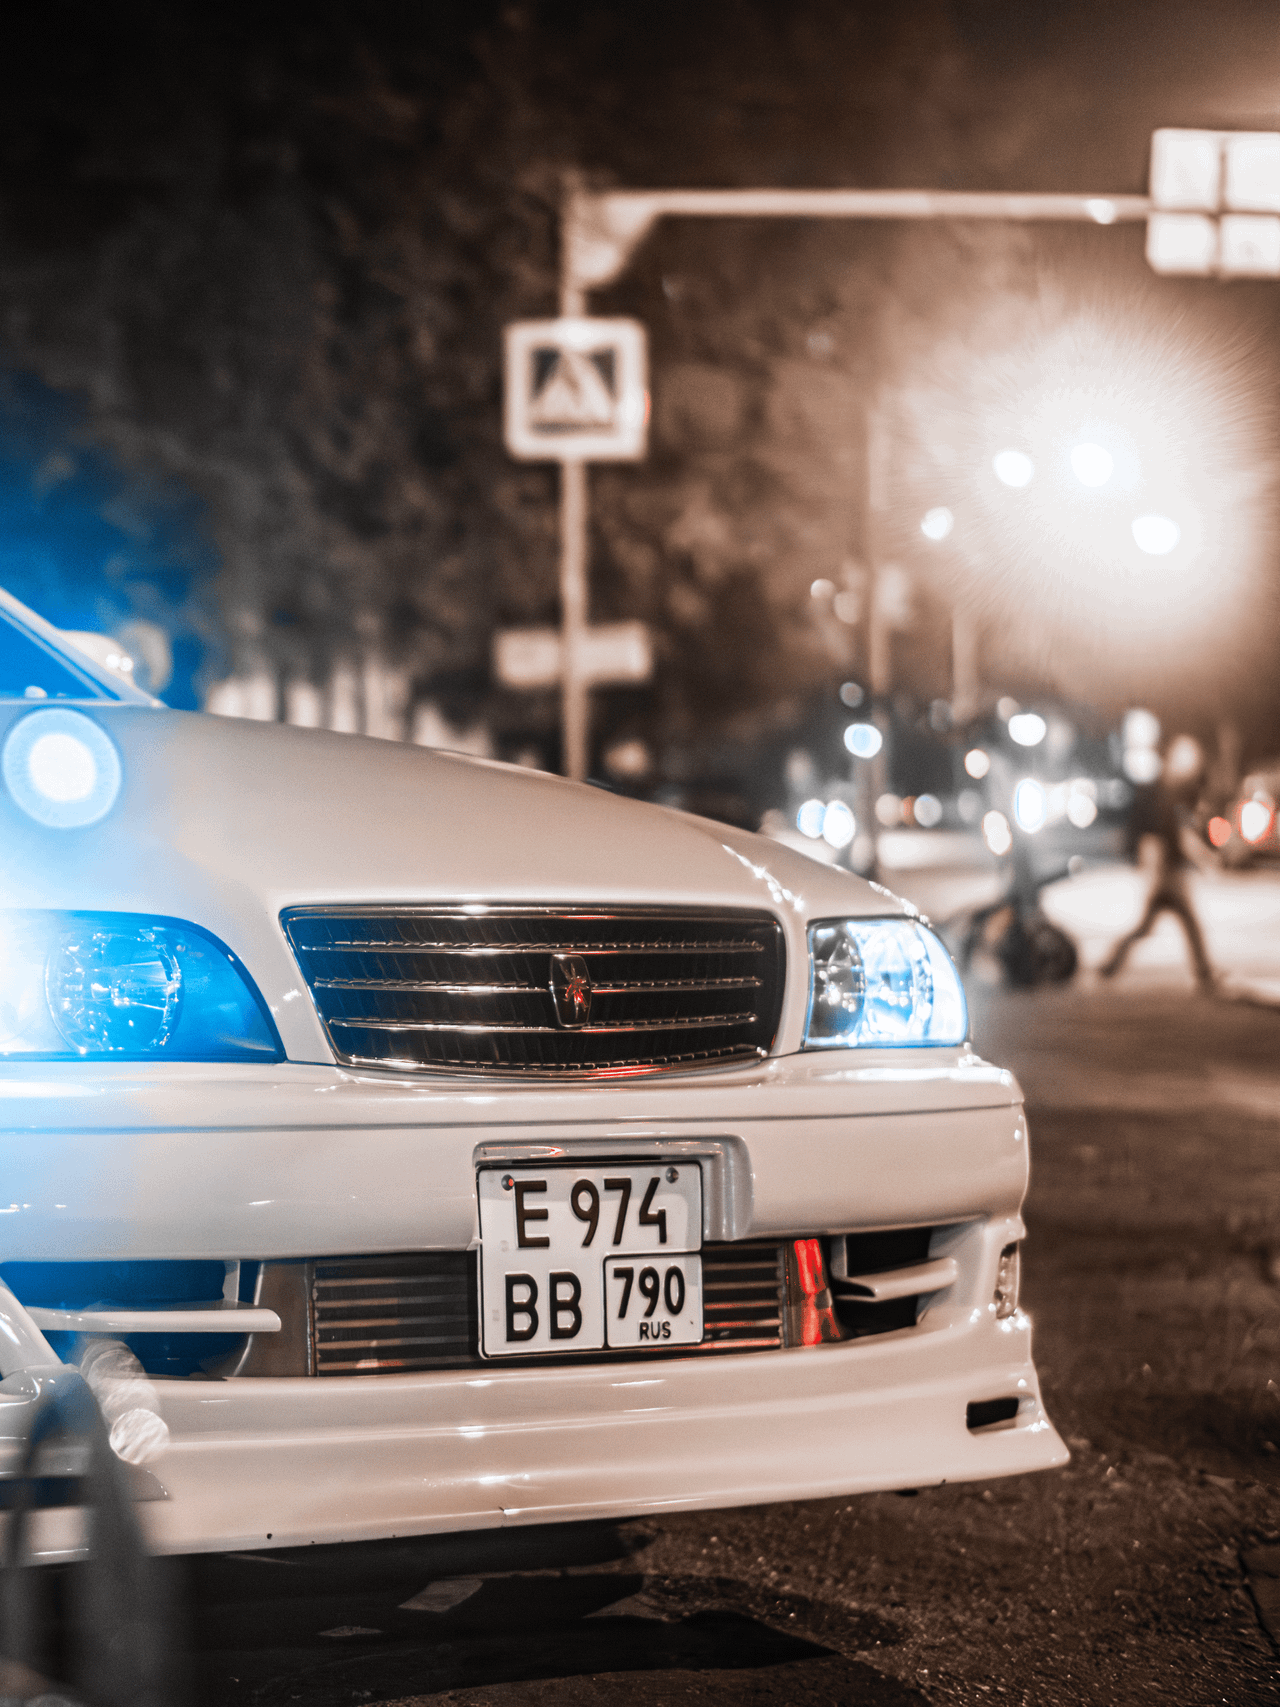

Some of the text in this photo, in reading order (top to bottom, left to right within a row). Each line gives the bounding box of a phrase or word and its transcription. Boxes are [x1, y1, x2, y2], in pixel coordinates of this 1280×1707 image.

[514, 1177, 667, 1248] E 974
[504, 1269, 583, 1342] BB
[613, 1265, 686, 1319] 790
[638, 1320, 672, 1340] RUS
